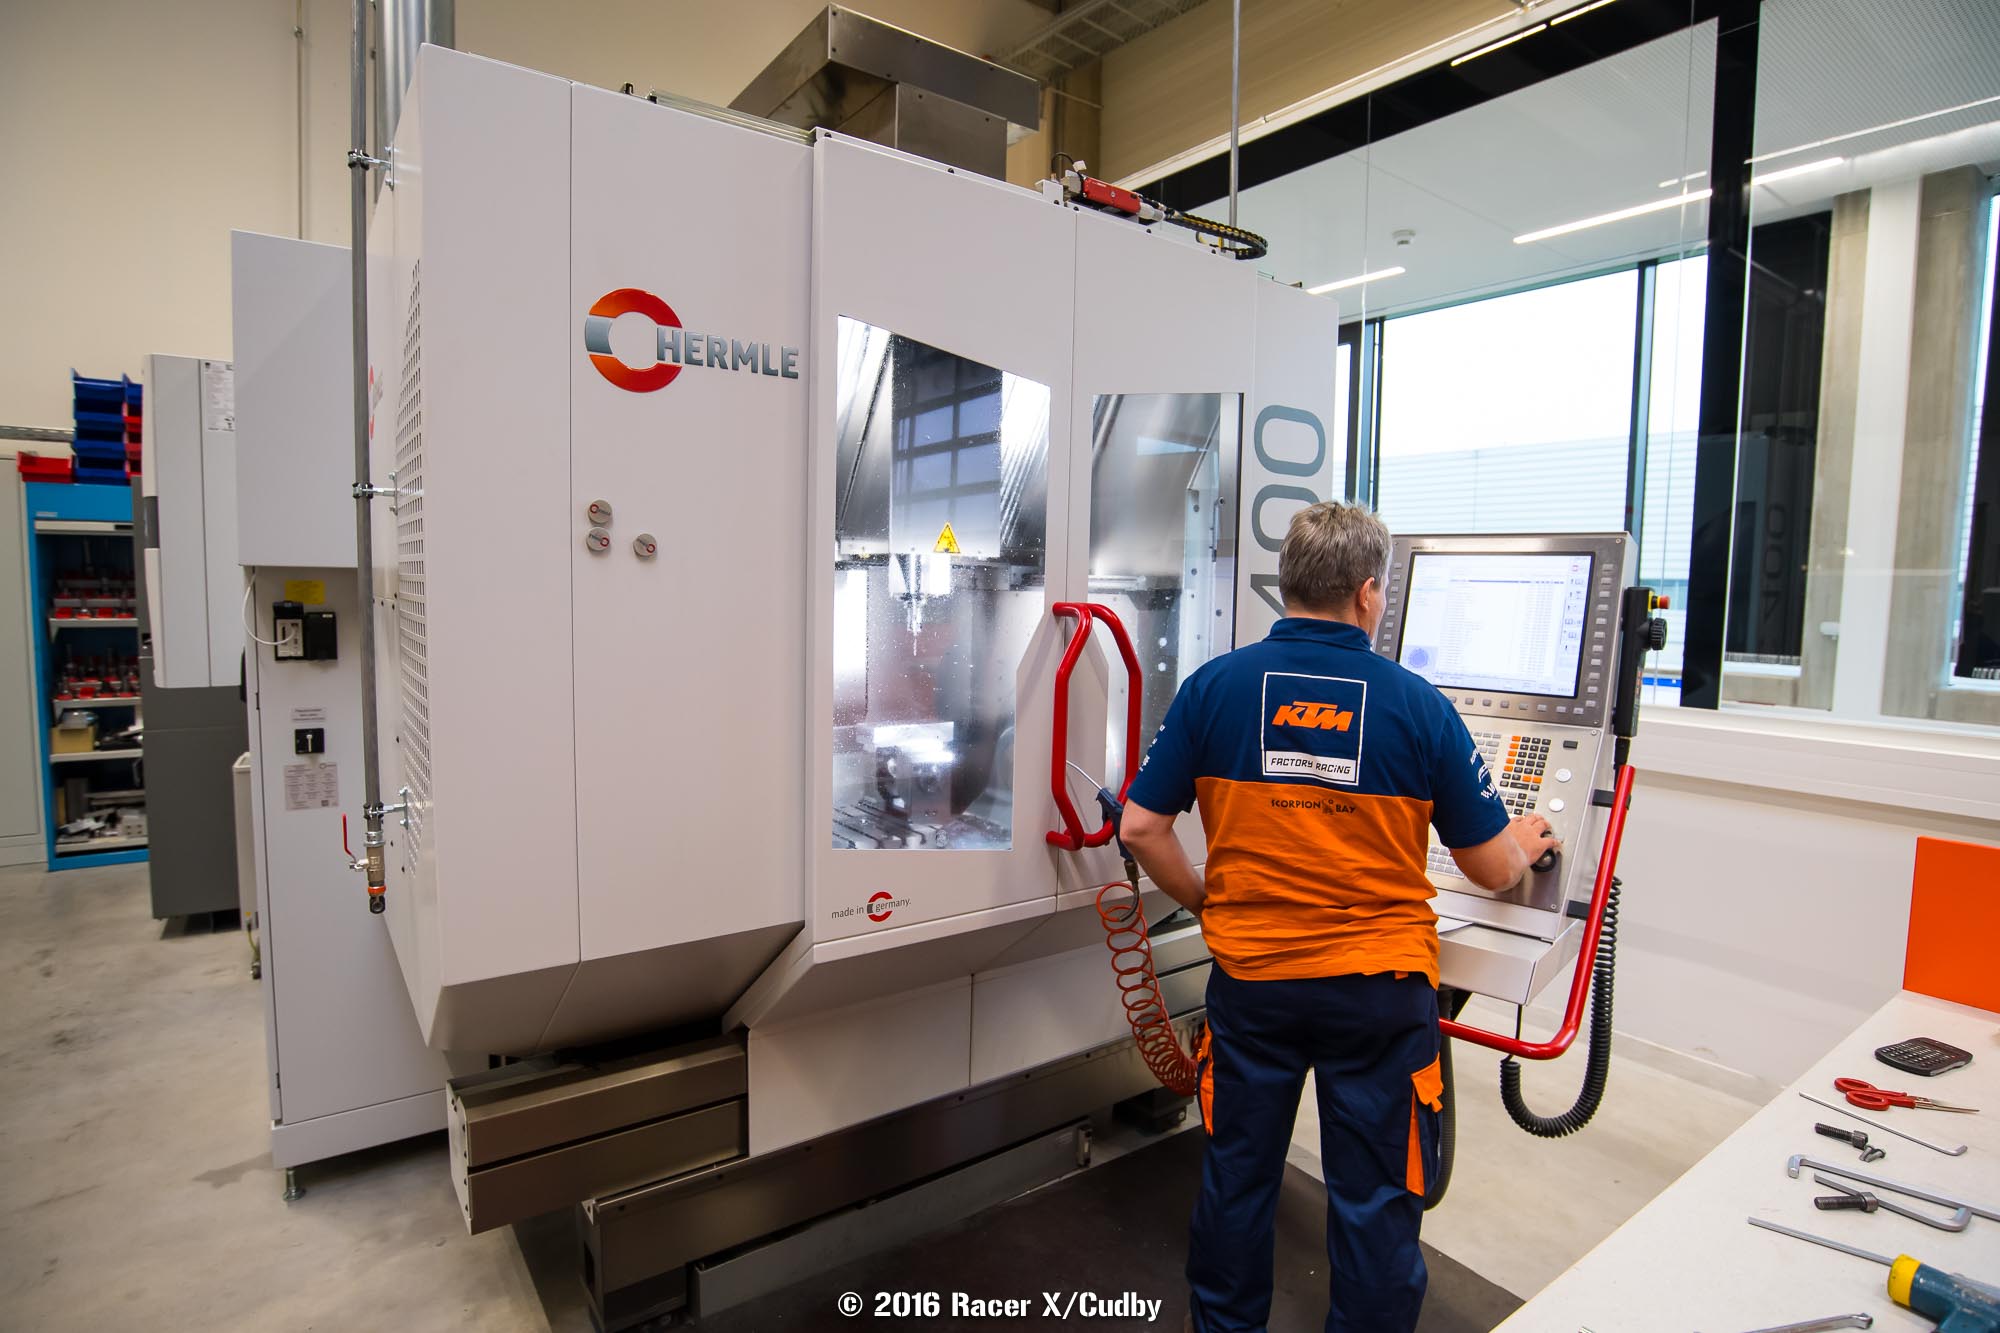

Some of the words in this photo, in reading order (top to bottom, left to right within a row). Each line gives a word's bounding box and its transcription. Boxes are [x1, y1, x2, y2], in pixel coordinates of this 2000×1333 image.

[656, 327, 799, 379] HERMLE
[1272, 701, 1354, 732] KTM
[1270, 758, 1313, 768] FACTORY
[1271, 799, 1321, 809] SCORPION
[1335, 804, 1356, 813] BAY
[831, 907, 855, 919] made
[856, 905, 864, 915] in
